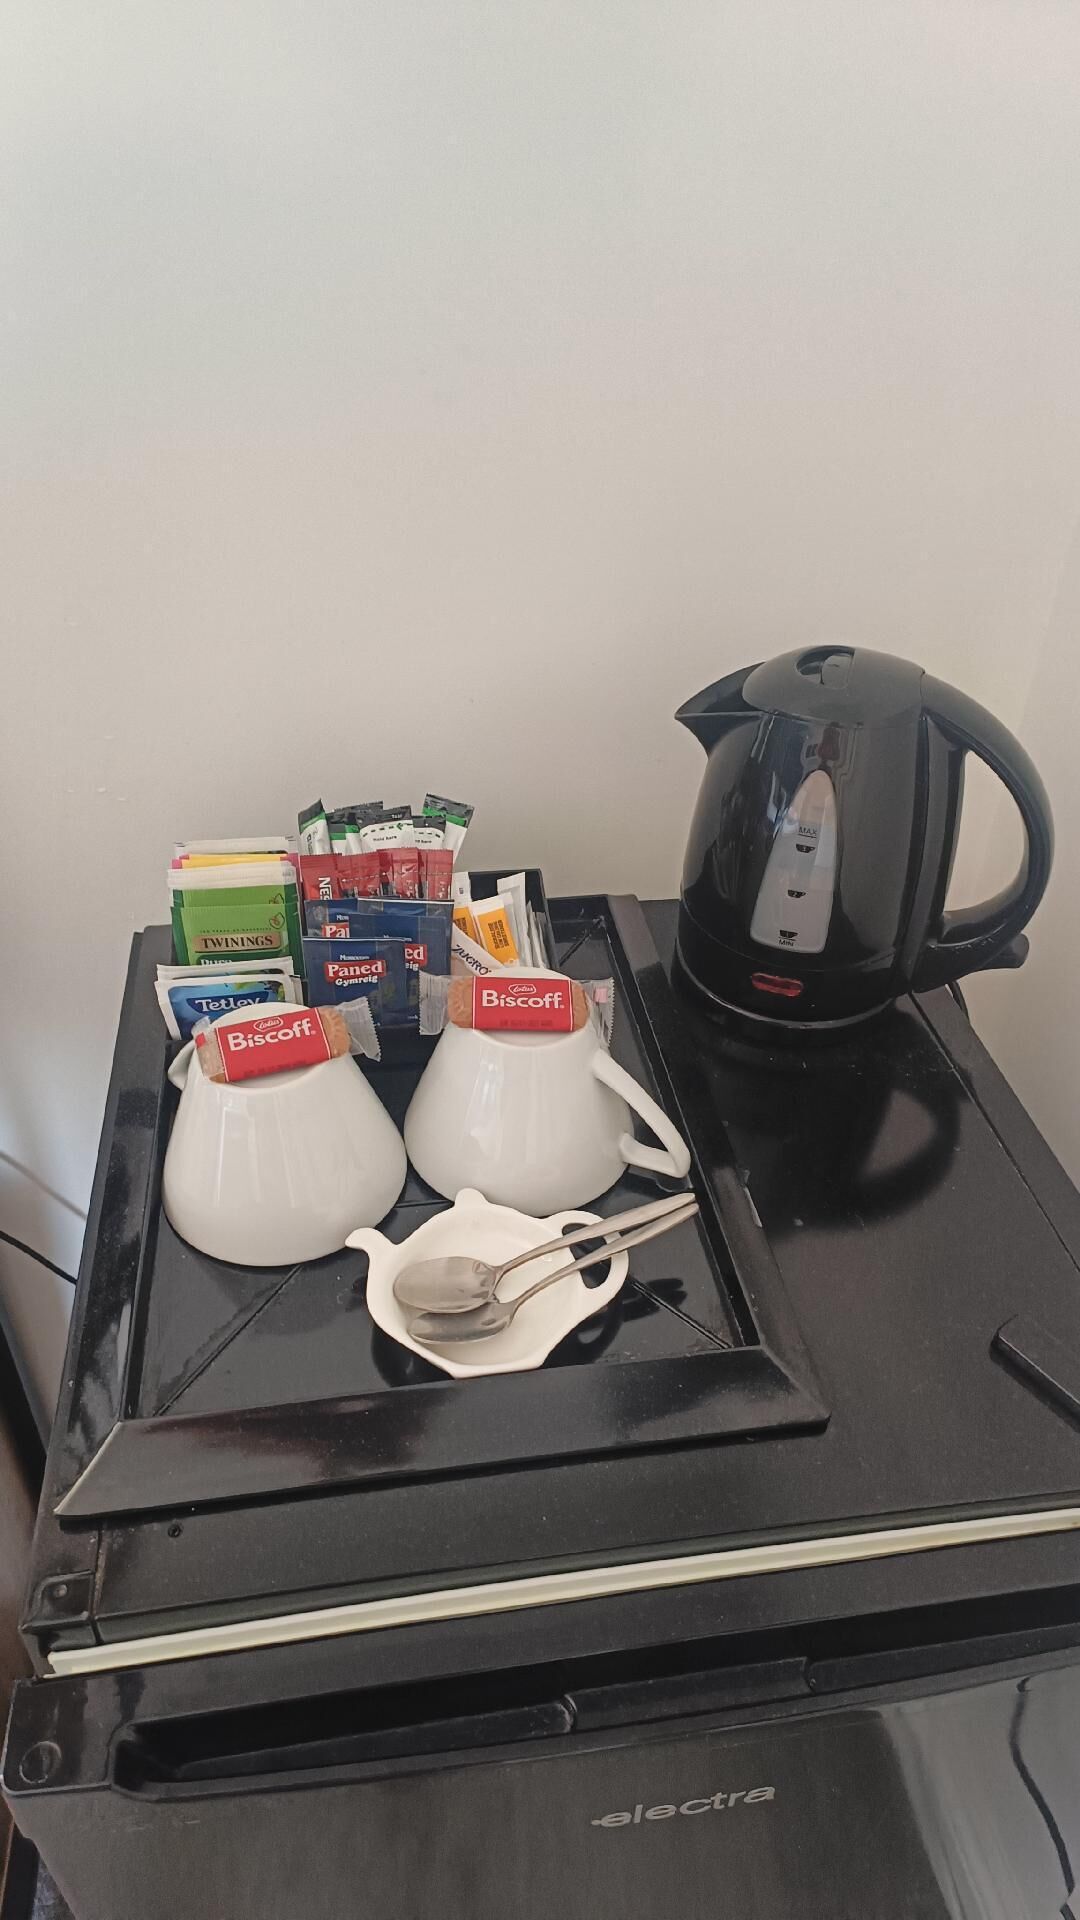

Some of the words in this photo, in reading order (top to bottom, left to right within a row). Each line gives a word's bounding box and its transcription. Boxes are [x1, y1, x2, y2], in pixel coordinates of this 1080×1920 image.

[799, 826, 817, 836] MAX
[201, 934, 273, 949] TWININGS
[779, 939, 794, 947] MIN
[327, 961, 383, 977] Paned
[335, 975, 378, 987] Gymreig
[481, 989, 563, 1009] Biscoff
[227, 1018, 312, 1051] Biscoff
[598, 1786, 776, 1828] electra
